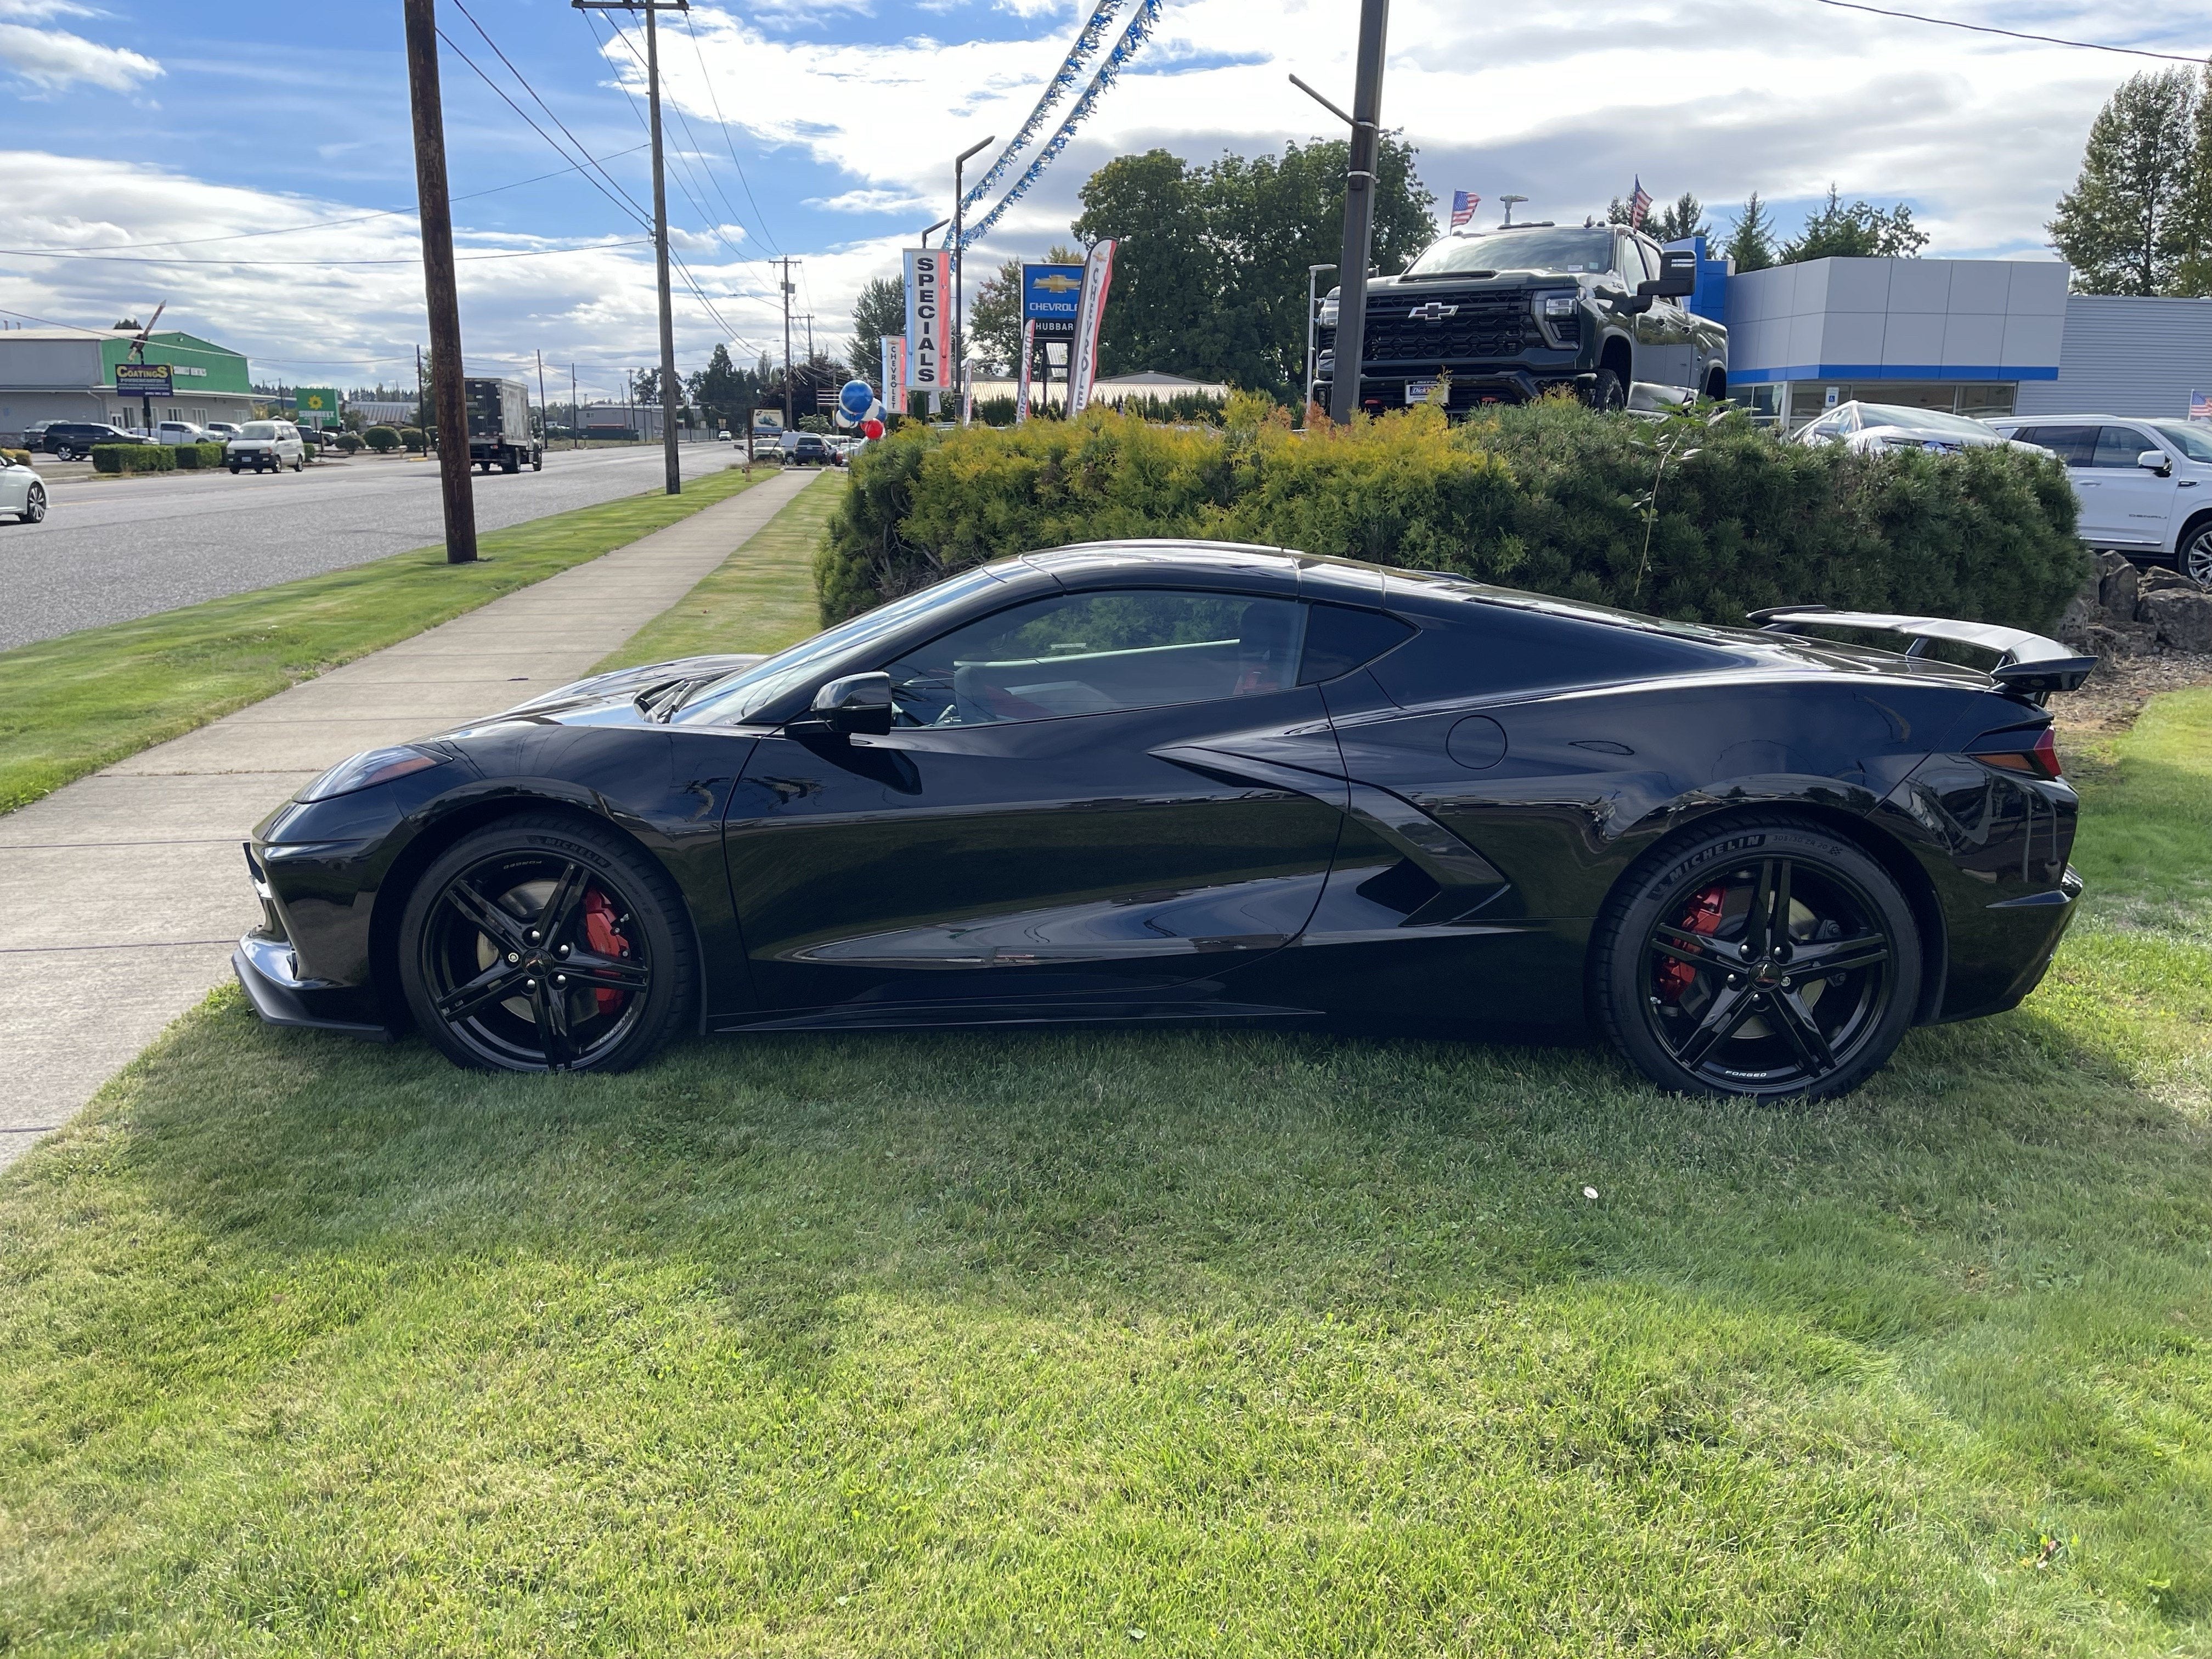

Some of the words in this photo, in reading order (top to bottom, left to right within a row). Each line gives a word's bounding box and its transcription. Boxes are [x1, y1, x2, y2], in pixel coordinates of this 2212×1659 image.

[917, 257, 935, 382] SPECIALS
[117, 365, 168, 378] COATINGS
[545, 838, 608, 866] MICHELIN
[1669, 835, 1760, 882] MICHELIN
[1774, 834, 1803, 843] 305/30
[599, 1006, 633, 1043] CORVETTE
